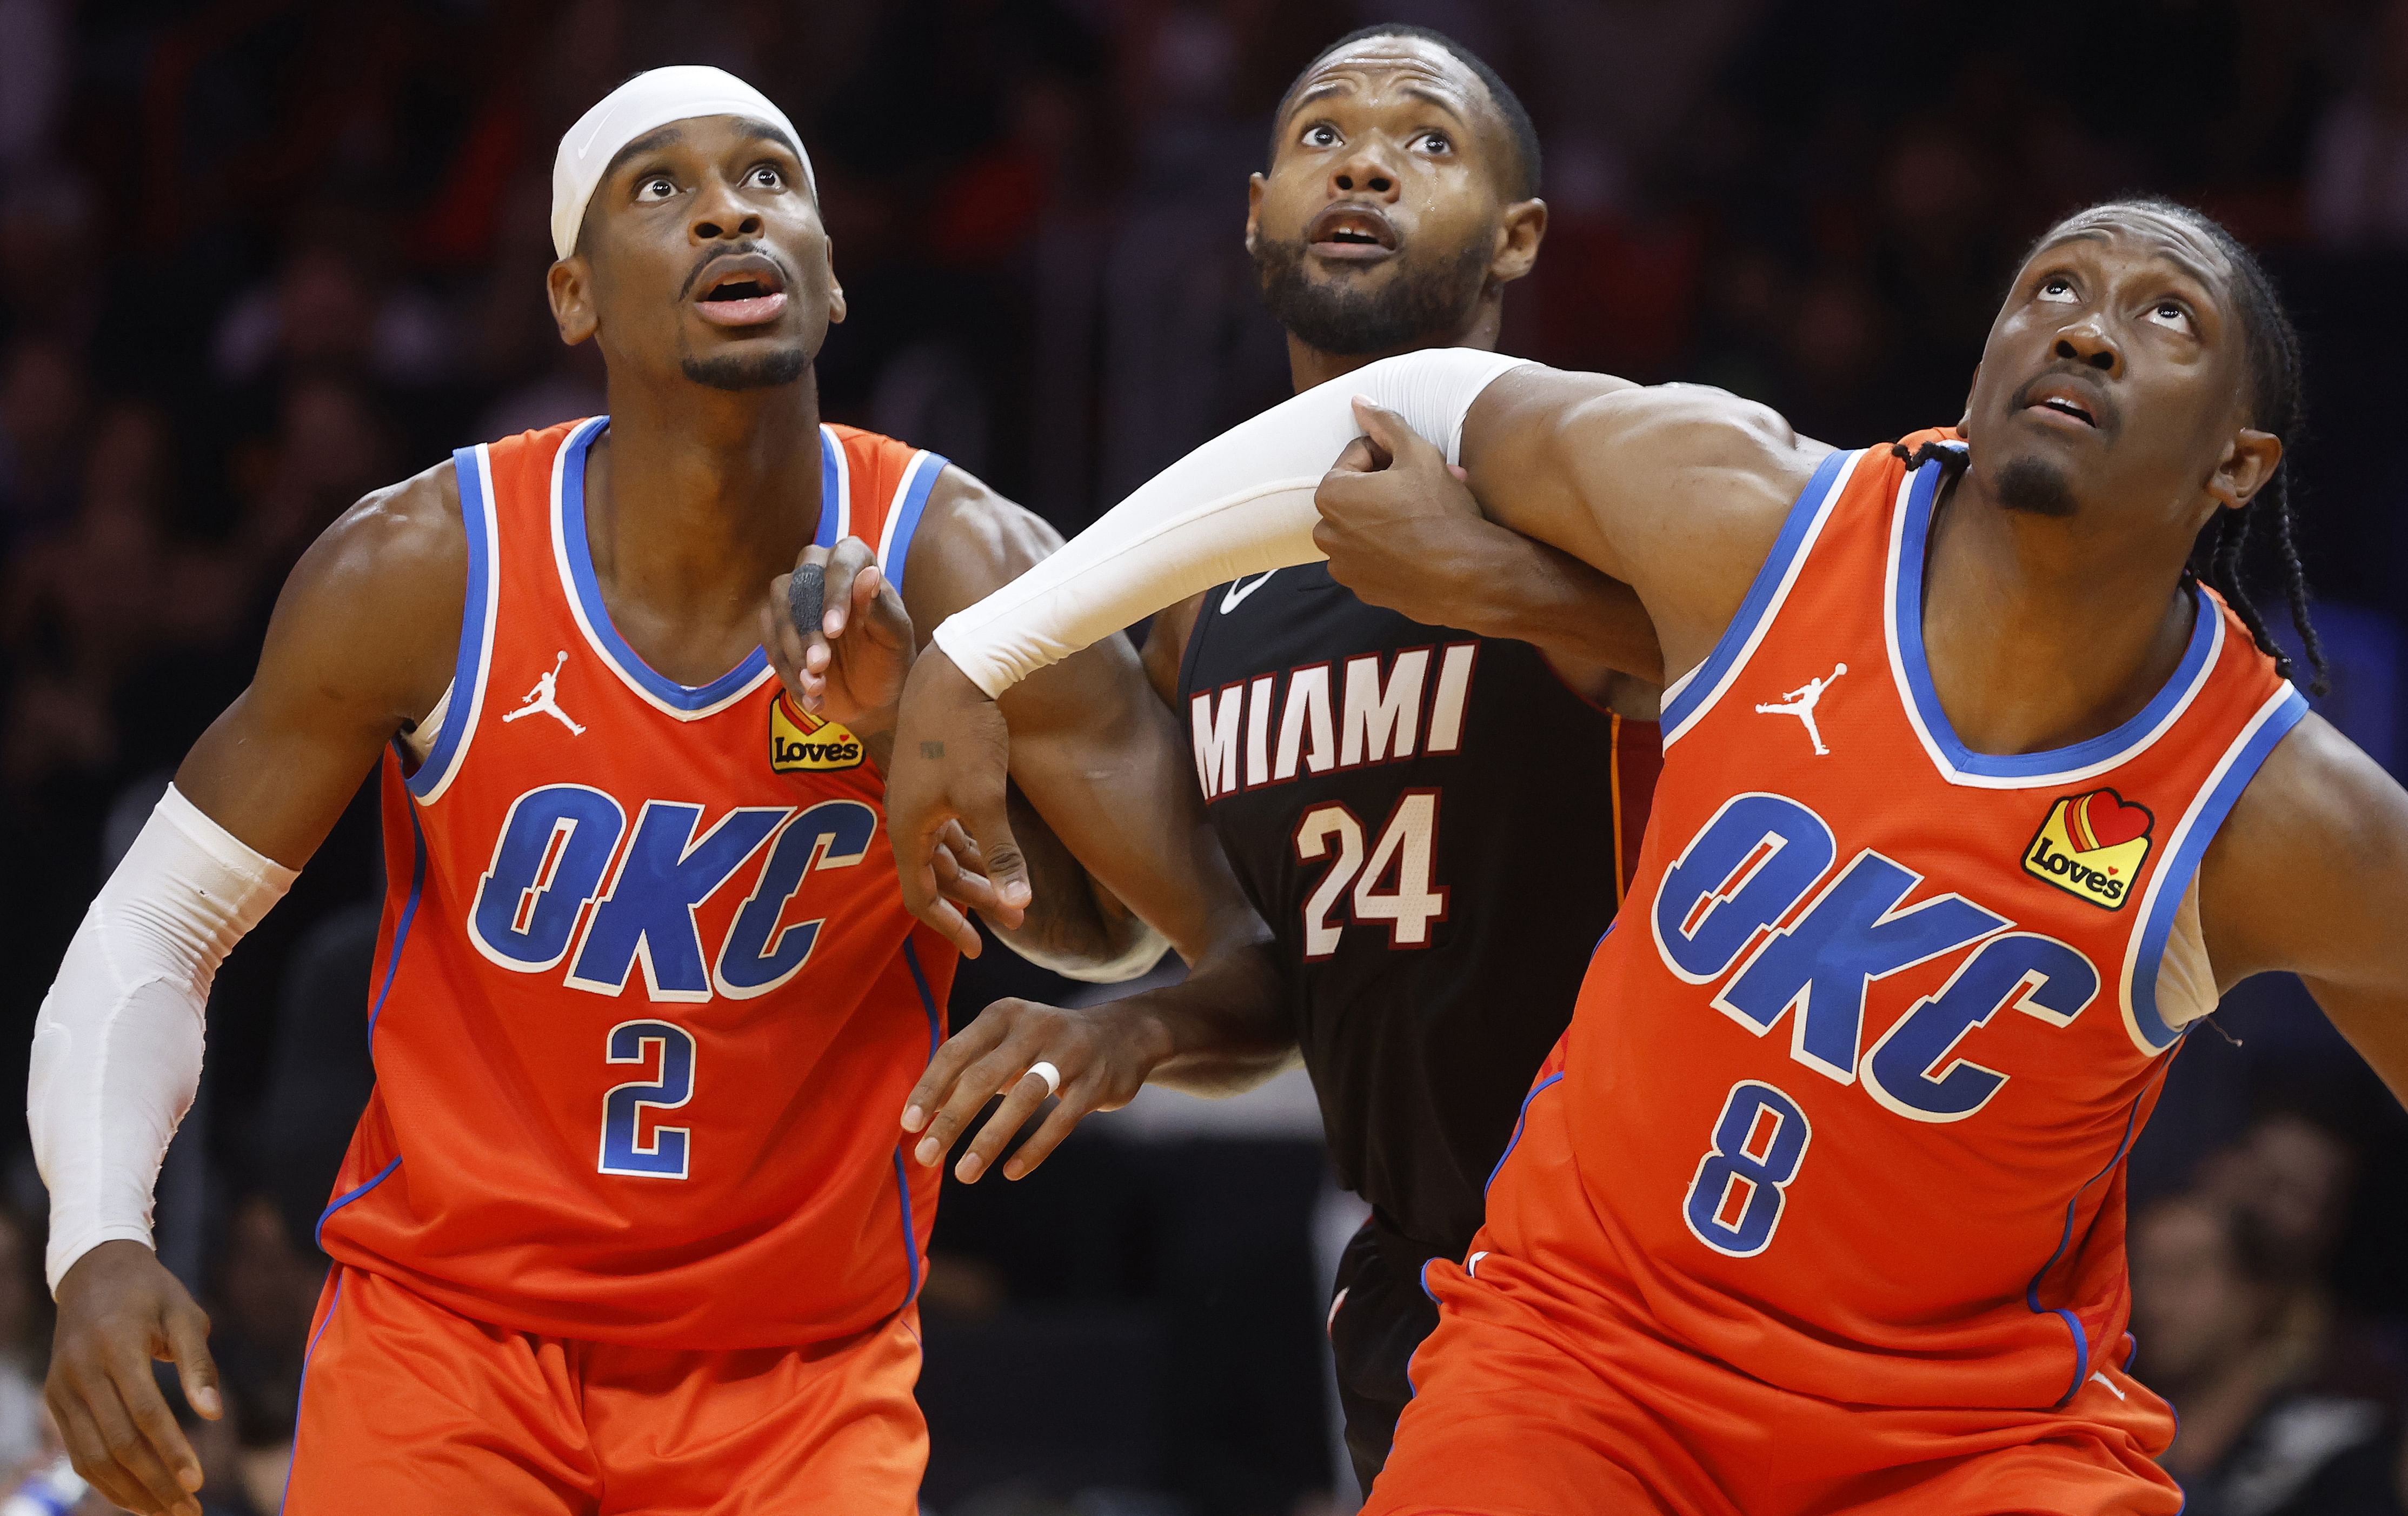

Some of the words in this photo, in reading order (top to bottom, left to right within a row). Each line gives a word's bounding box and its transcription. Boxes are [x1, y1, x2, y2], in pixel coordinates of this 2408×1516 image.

[1189, 640, 1481, 804] MIAMI
[467, 783, 877, 1002] OKC
[1292, 787, 1451, 962] 24
[1651, 792, 2101, 1122] OKC
[598, 1019, 696, 1180] 2
[1683, 1079, 1812, 1258] 8
